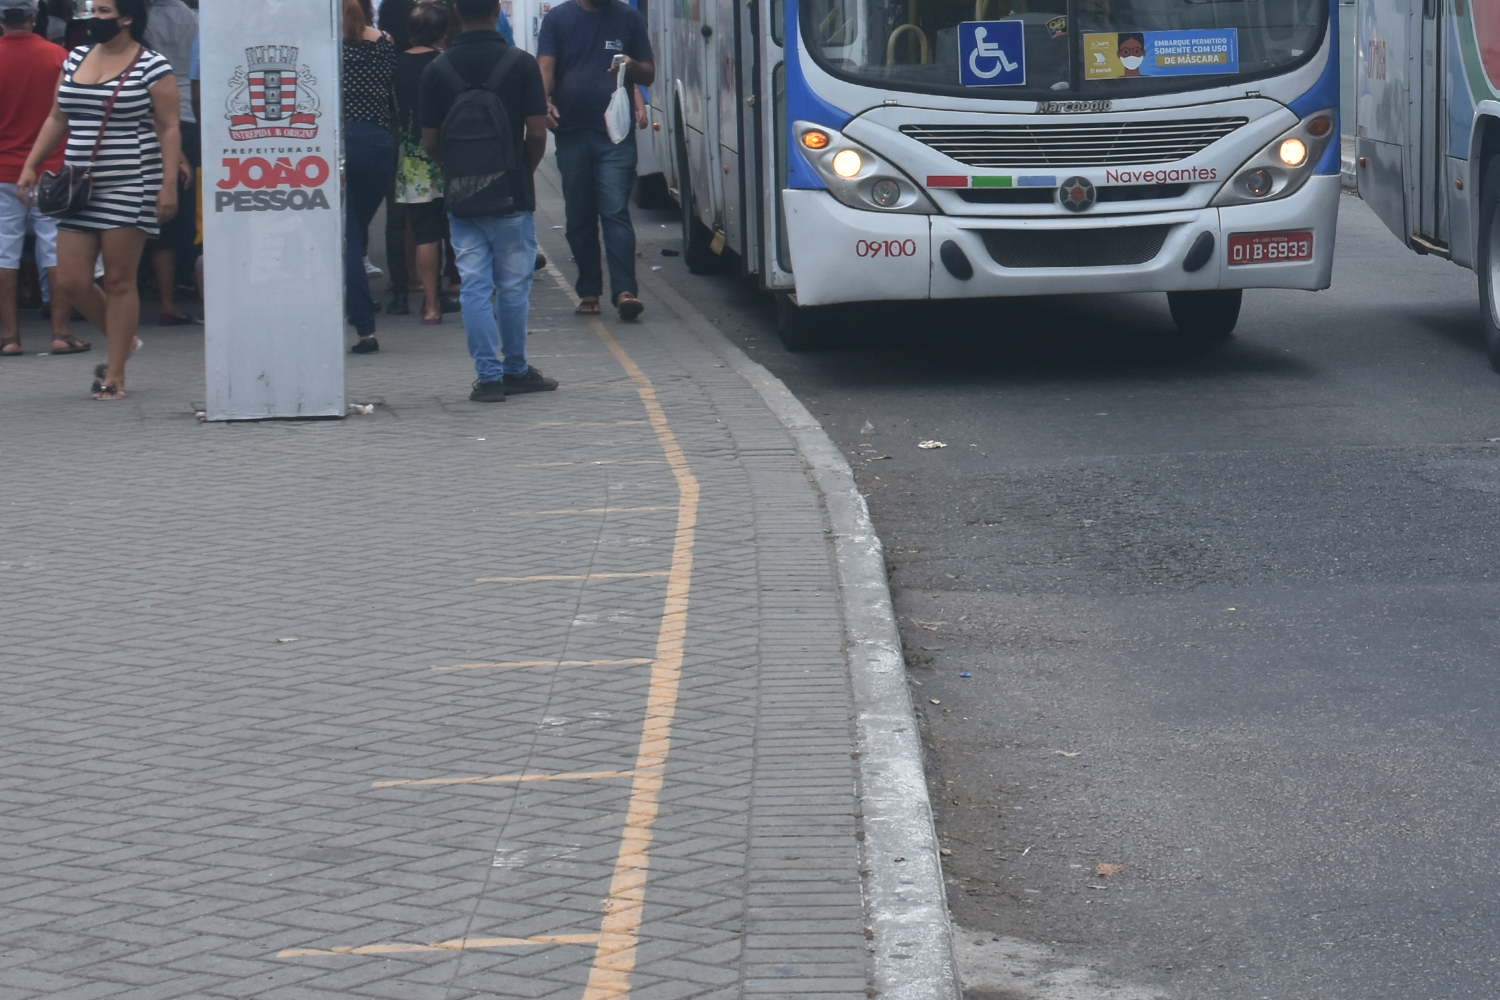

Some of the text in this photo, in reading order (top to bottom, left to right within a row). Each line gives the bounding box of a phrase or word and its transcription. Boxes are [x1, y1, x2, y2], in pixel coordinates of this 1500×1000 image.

[1154, 37, 1227, 47] EMBARQUE PERMITIDO
[1154, 44, 1228, 55] SOMENTE COM USO
[1164, 54, 1220, 65] DE MÁSCARA
[1035, 100, 1113, 113] Marcopolo
[231, 128, 272, 140] INTREPIDA
[284, 128, 316, 139] ORIGINE
[223, 147, 302, 155] PREFEITURA
[215, 155, 330, 190] JOÃO
[1105, 165, 1217, 185] Navegantes
[215, 188, 331, 212] PESSOA
[855, 238, 916, 259] 09100
